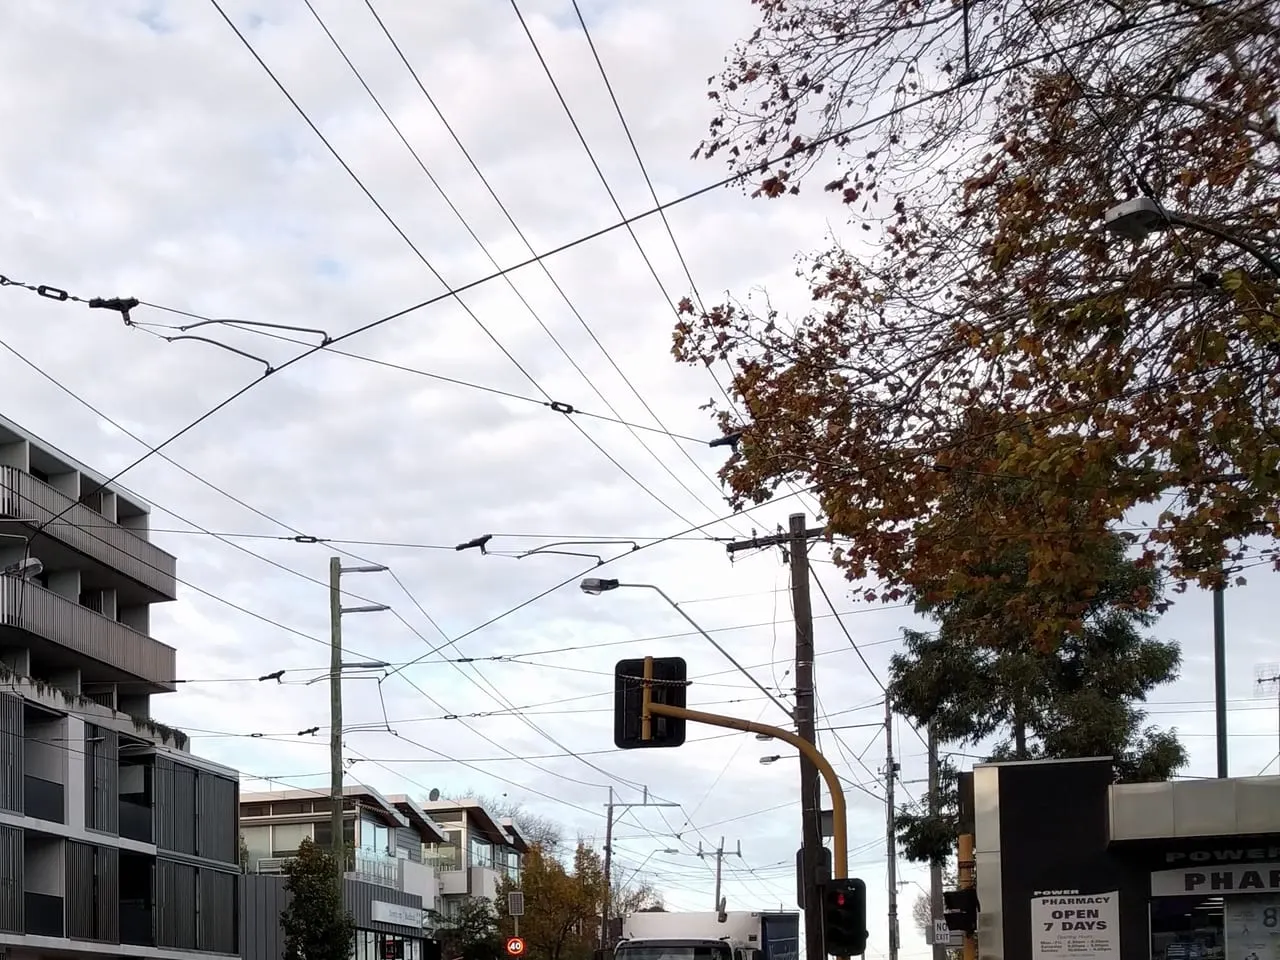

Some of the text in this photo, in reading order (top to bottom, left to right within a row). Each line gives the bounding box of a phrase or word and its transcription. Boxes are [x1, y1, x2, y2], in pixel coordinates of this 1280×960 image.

[1042, 897, 1111, 906] PHARMACY
[1051, 909, 1099, 919] OPEN
[1263, 907, 1278, 928] 8
[936, 922, 948, 932] NO
[1043, 920, 1108, 931] 7 DAYS
[936, 933, 949, 941] EXIT
[510, 942, 521, 950] 40
